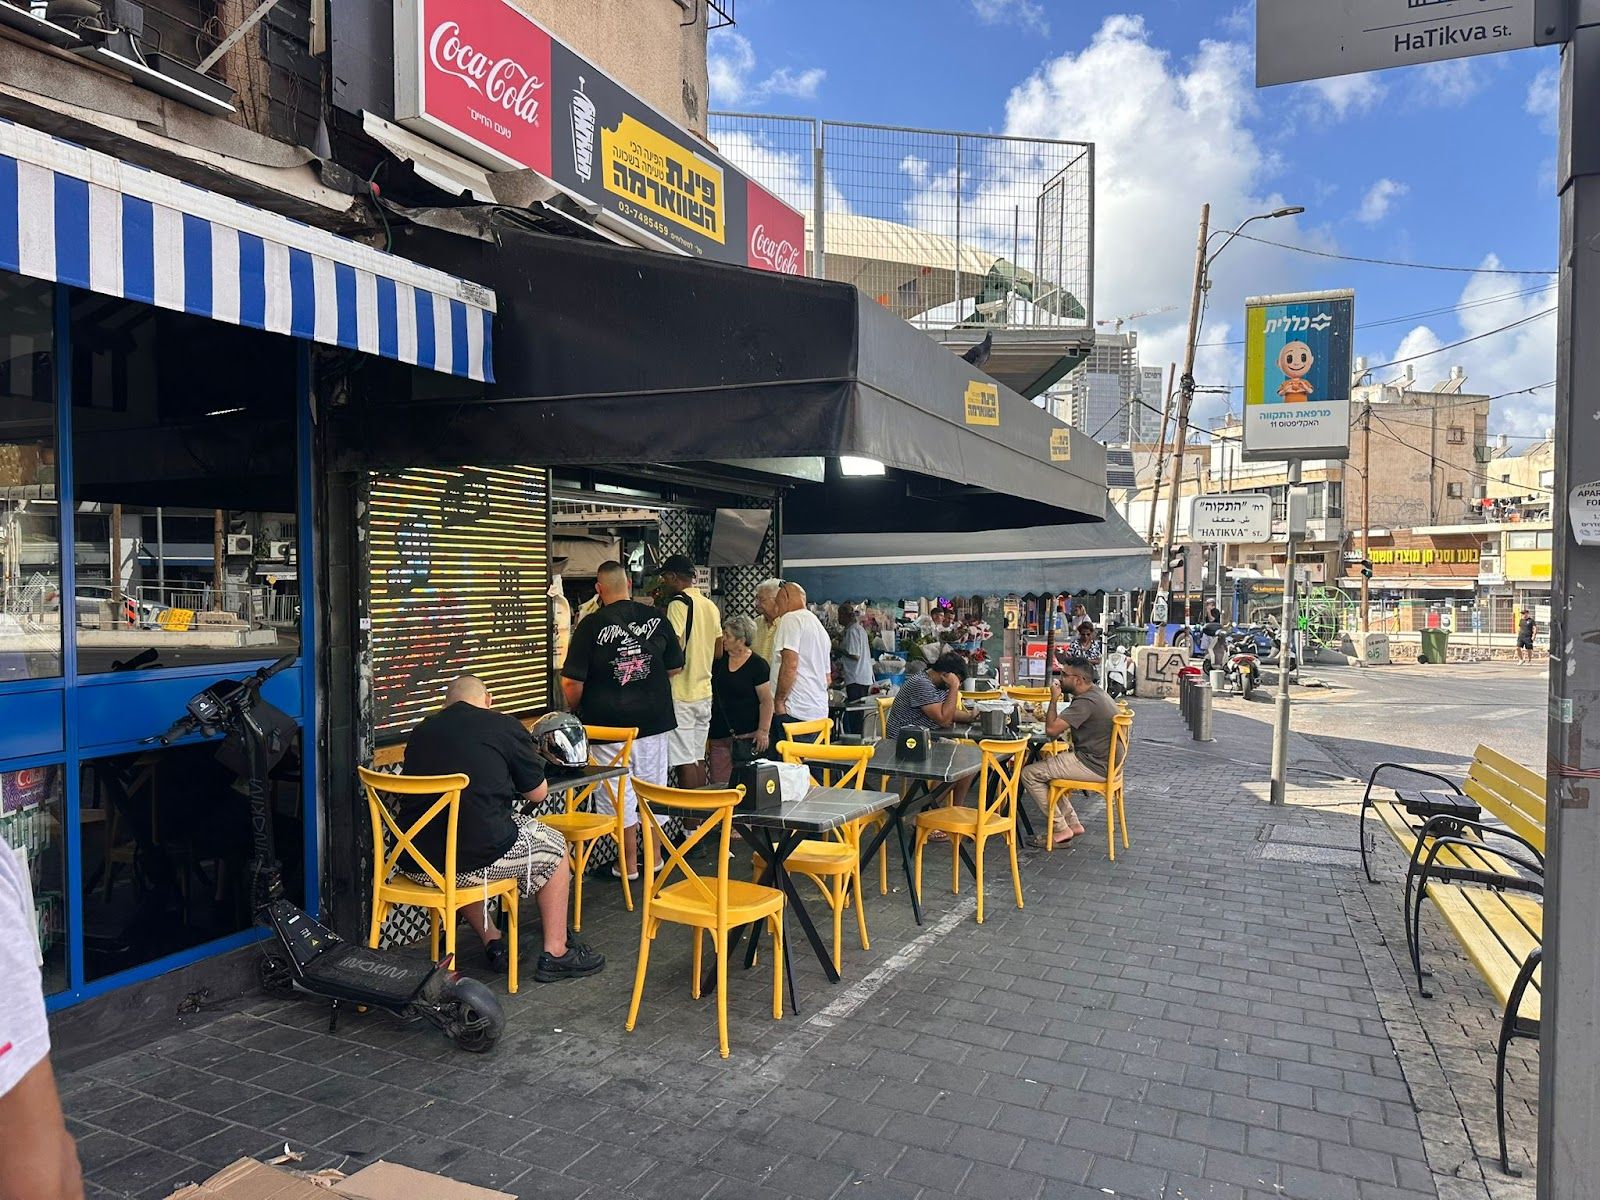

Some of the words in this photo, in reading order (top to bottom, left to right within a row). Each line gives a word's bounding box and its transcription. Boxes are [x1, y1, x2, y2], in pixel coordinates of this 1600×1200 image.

[1394, 25, 1487, 52] HaTikva
[1492, 25, 1512, 38] St.
[429, 21, 544, 124] Coca-Cola
[470, 109, 493, 129] החיים
[494, 122, 512, 139] טעם
[612, 145, 640, 169] בשכונה
[629, 140, 642, 157] הכי
[643, 148, 664, 167] הפינה
[641, 161, 664, 181] טעימה
[665, 156, 715, 207] פינת
[612, 160, 717, 233] השווארמה
[618, 200, 669, 236] 03-7485459
[1263, 315, 1310, 333] כללית
[1260, 411, 1294, 421] התקווה
[1296, 409, 1331, 418] מרפאת
[1279, 420, 1319, 428] האקליפטוס
